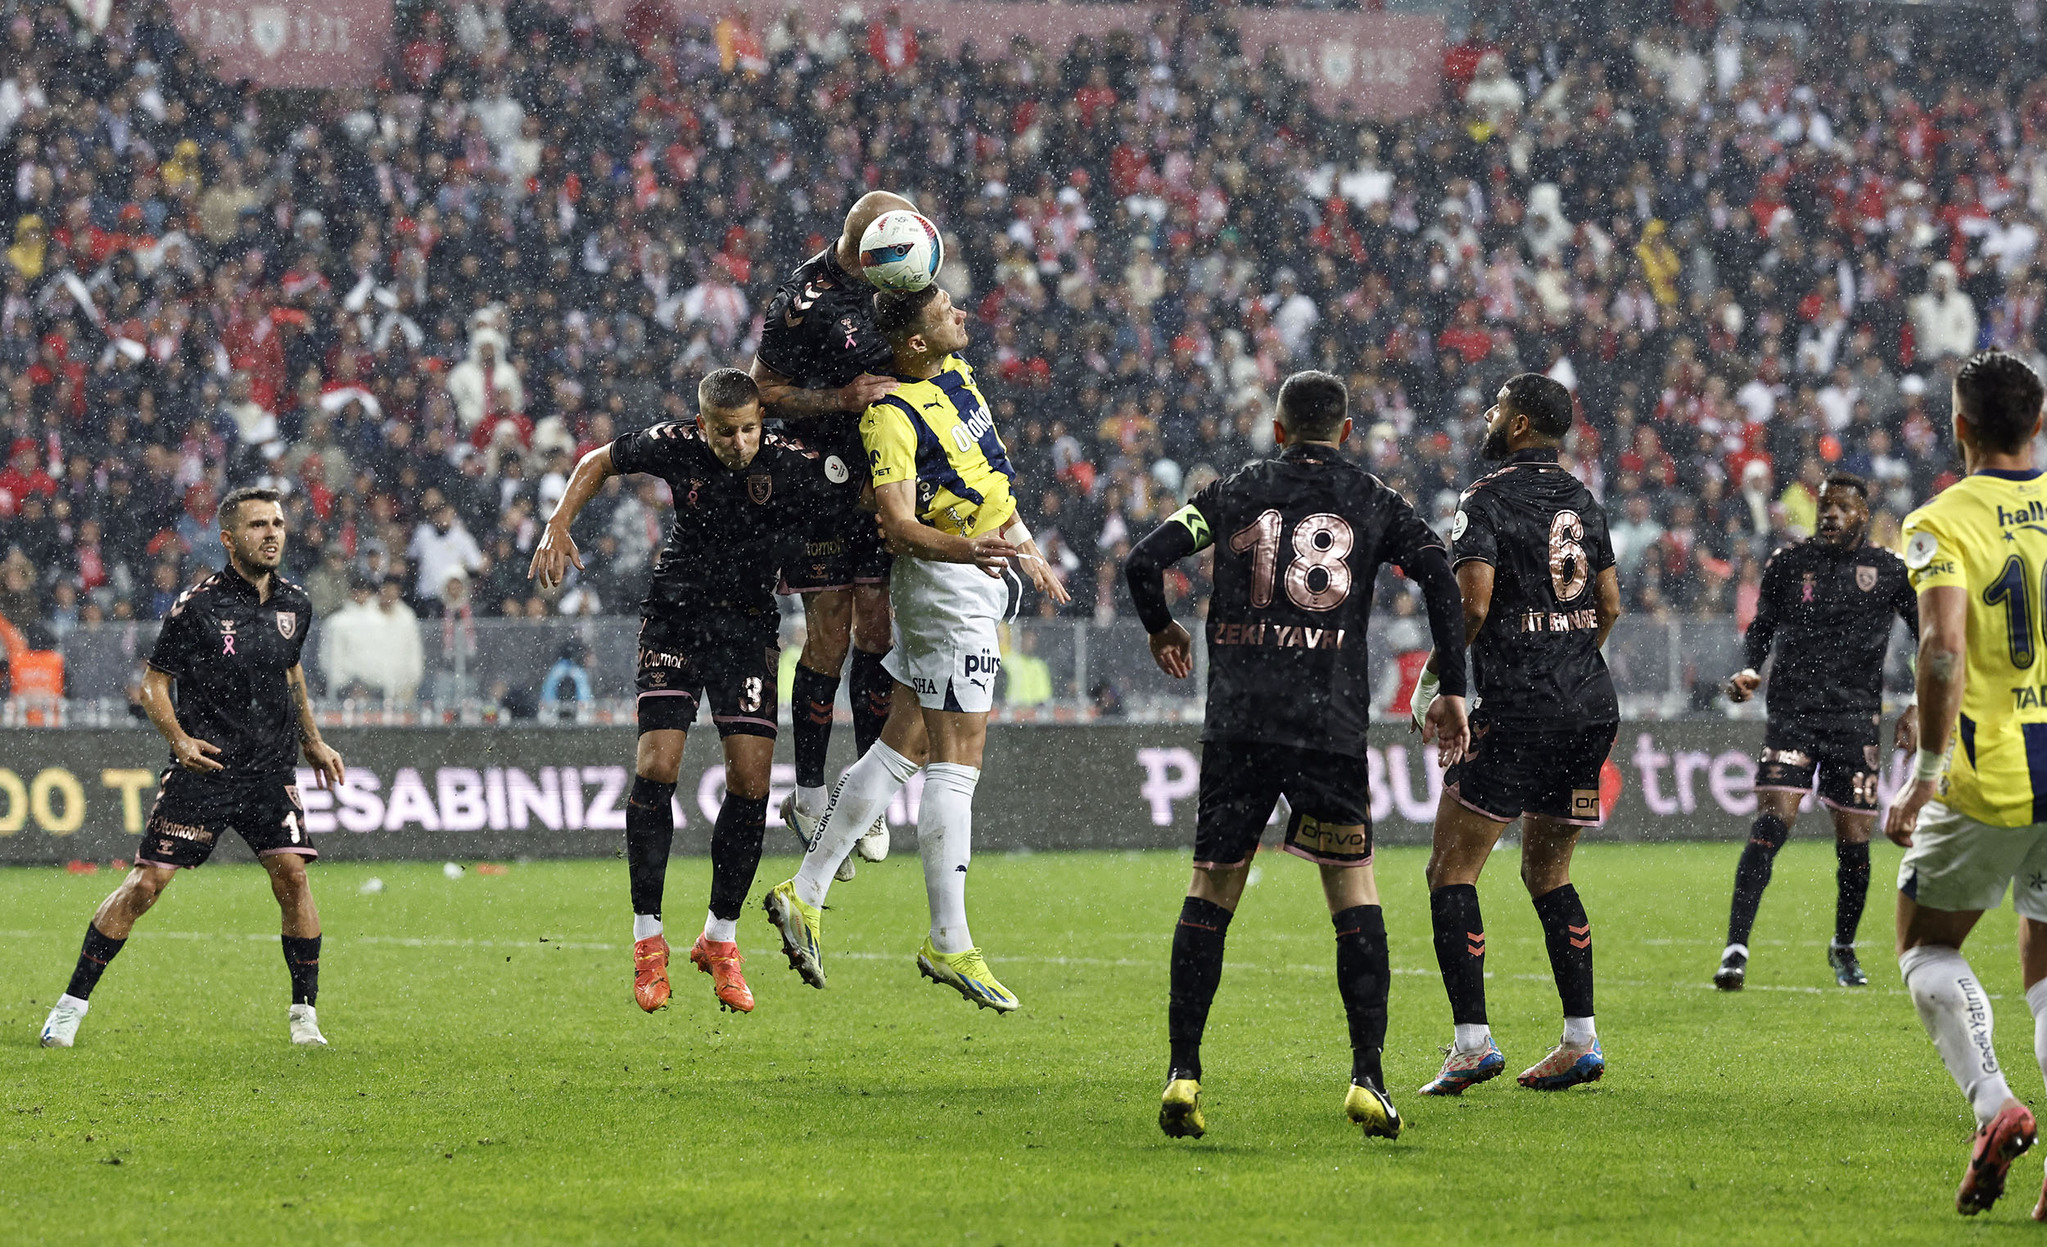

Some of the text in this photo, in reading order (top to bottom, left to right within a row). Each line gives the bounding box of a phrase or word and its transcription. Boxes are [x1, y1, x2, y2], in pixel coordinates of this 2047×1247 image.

[1996, 501, 2047, 527] hall
[1229, 508, 1354, 612] 18
[1549, 509, 1588, 602] 6
[1983, 554, 2047, 669] 1
[739, 676, 767, 713] 3
[281, 810, 302, 844] 1
